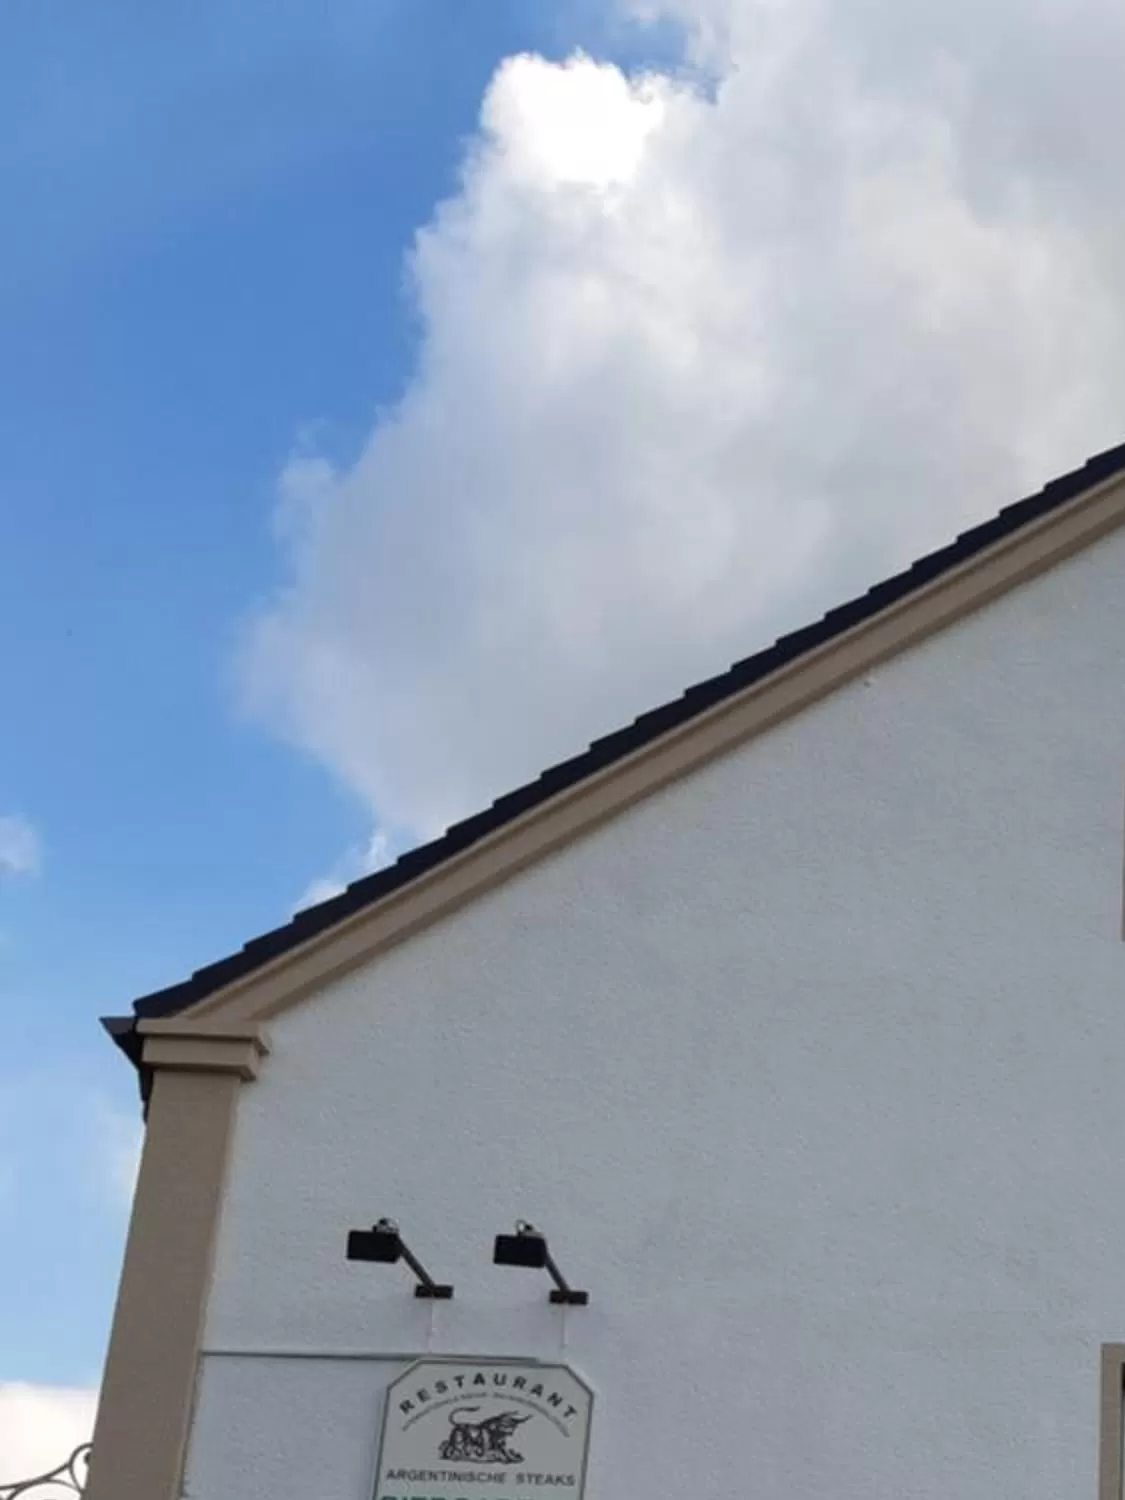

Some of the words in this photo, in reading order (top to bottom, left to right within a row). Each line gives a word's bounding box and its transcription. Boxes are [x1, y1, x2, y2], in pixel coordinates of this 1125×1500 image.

[399, 1372, 577, 1419] RESTAURANT
[386, 1468, 507, 1484] ARGENTINISCHE
[515, 1473, 576, 1487] STEAKS
